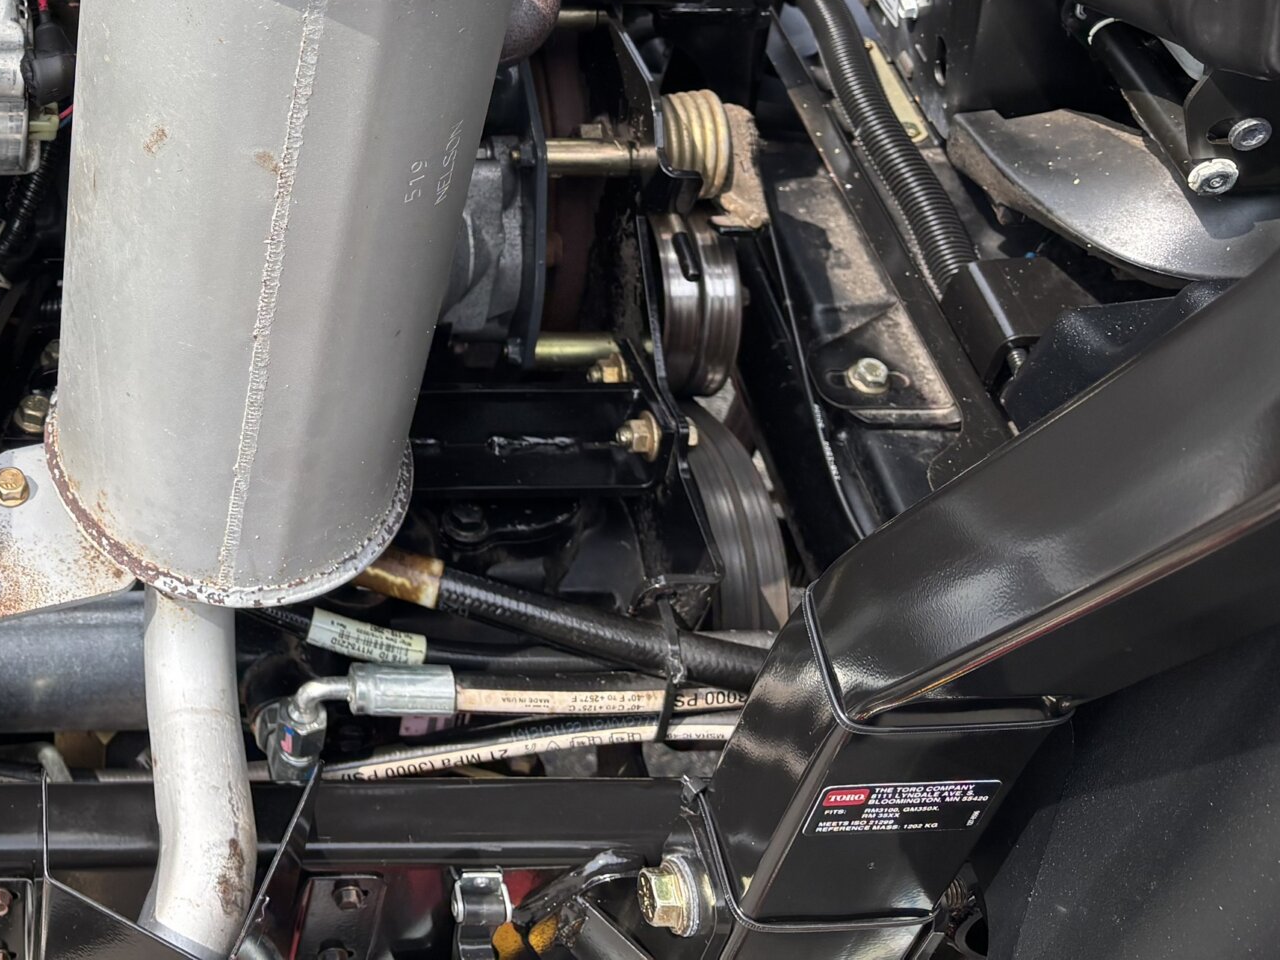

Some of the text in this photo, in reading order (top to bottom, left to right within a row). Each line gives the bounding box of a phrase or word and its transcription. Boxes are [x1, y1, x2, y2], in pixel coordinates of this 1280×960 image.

[434, 120, 463, 205] NELSON
[441, 753, 481, 765] MPa
[490, 749, 508, 759] 21
[385, 760, 436, 776] (3000
[868, 797, 942, 805] BLOOMINGTON,
